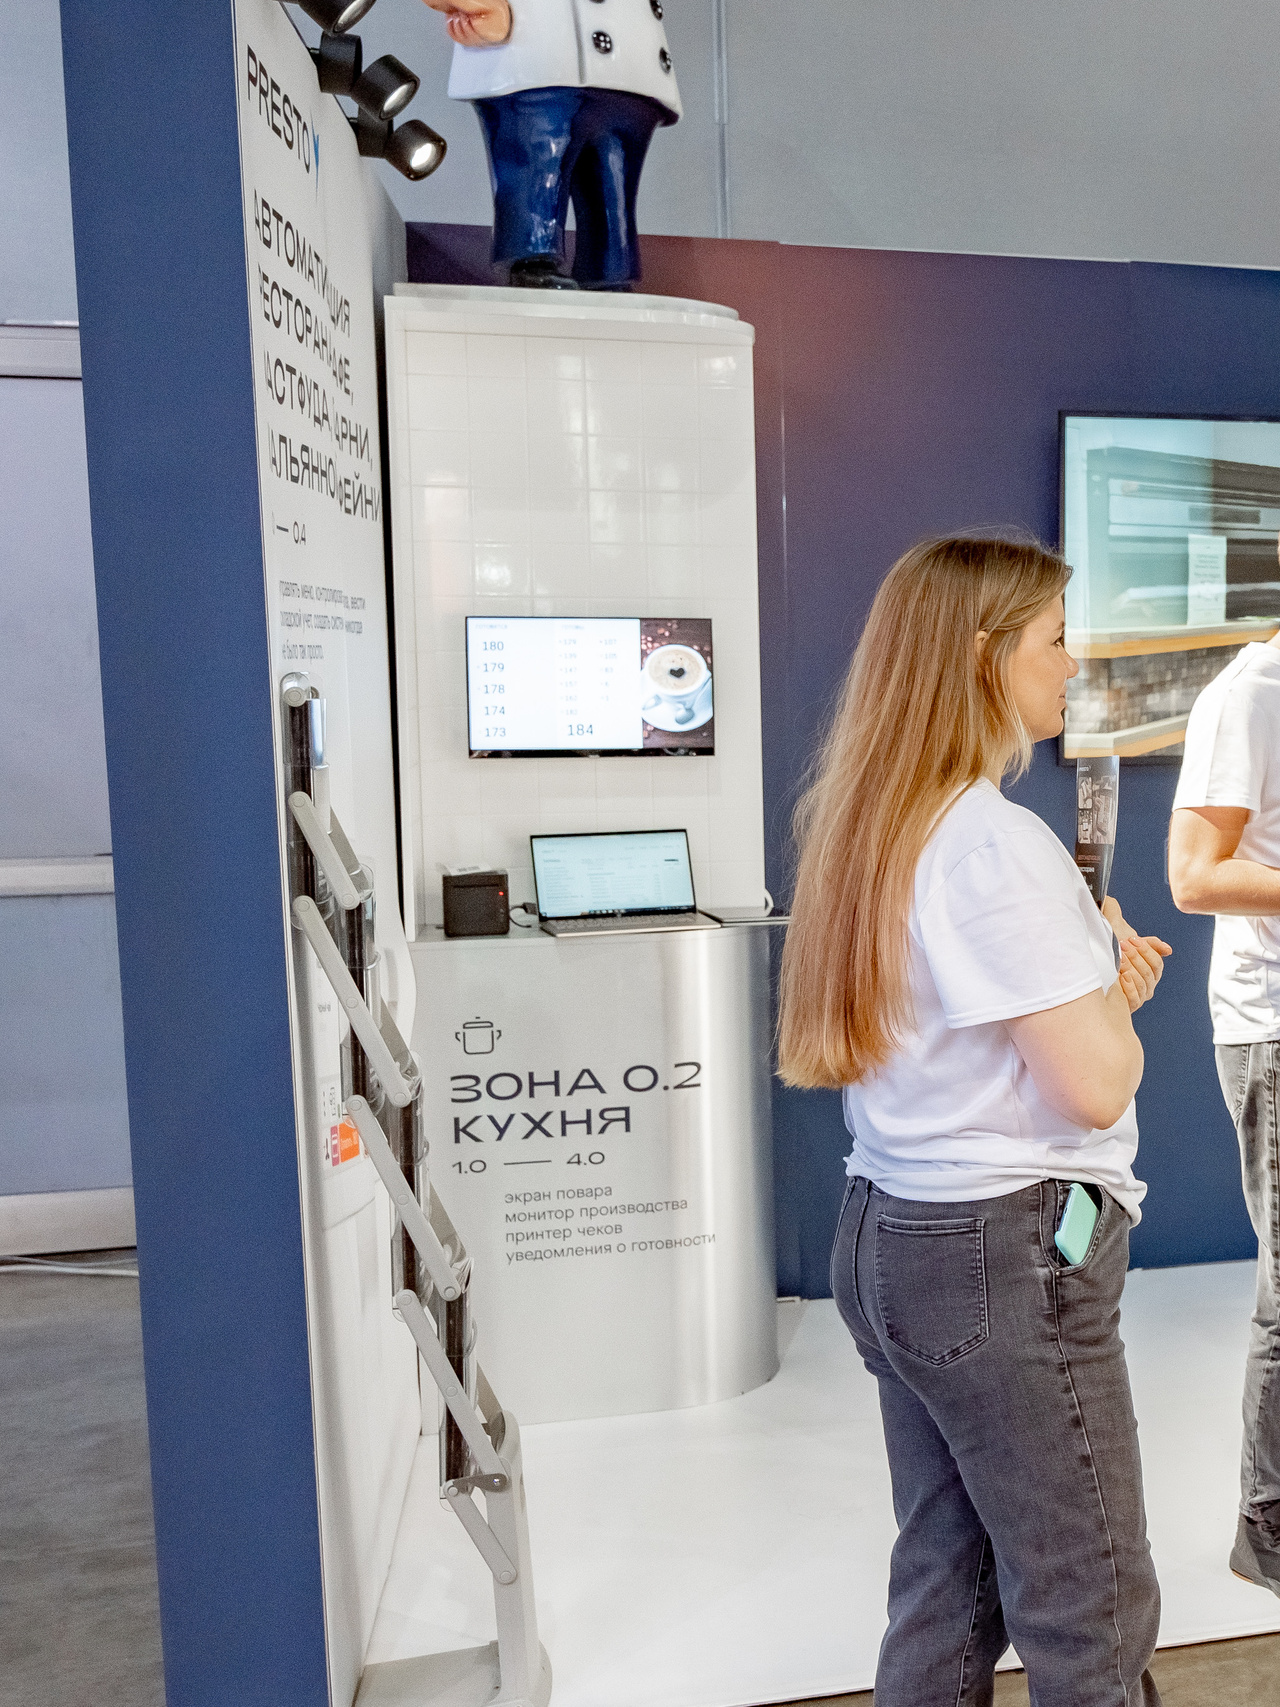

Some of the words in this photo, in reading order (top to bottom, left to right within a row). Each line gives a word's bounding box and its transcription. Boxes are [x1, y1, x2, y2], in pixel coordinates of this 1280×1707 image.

[247, 44, 311, 174] PRESTO
[482, 640, 504, 651] 180
[484, 662, 505, 672] 179
[484, 684, 505, 694] 178
[484, 706, 506, 716] 174
[485, 727, 506, 738] 173
[567, 723, 594, 736] 184
[450, 1068, 607, 1103] ЗОНА
[622, 1061, 702, 1093] 0.2
[453, 1106, 632, 1144] КУХНЯ
[451, 1159, 487, 1175] 1.0
[566, 1151, 605, 1166] 4.0
[504, 1189, 552, 1206] экран
[556, 1185, 613, 1202] повара
[504, 1206, 575, 1223] монитор
[580, 1199, 689, 1220] производства
[505, 1227, 572, 1243] принтер
[576, 1223, 623, 1237] чеков
[505, 1242, 612, 1265] уведомления
[616, 1242, 627, 1253] о
[631, 1233, 717, 1252] готовности
